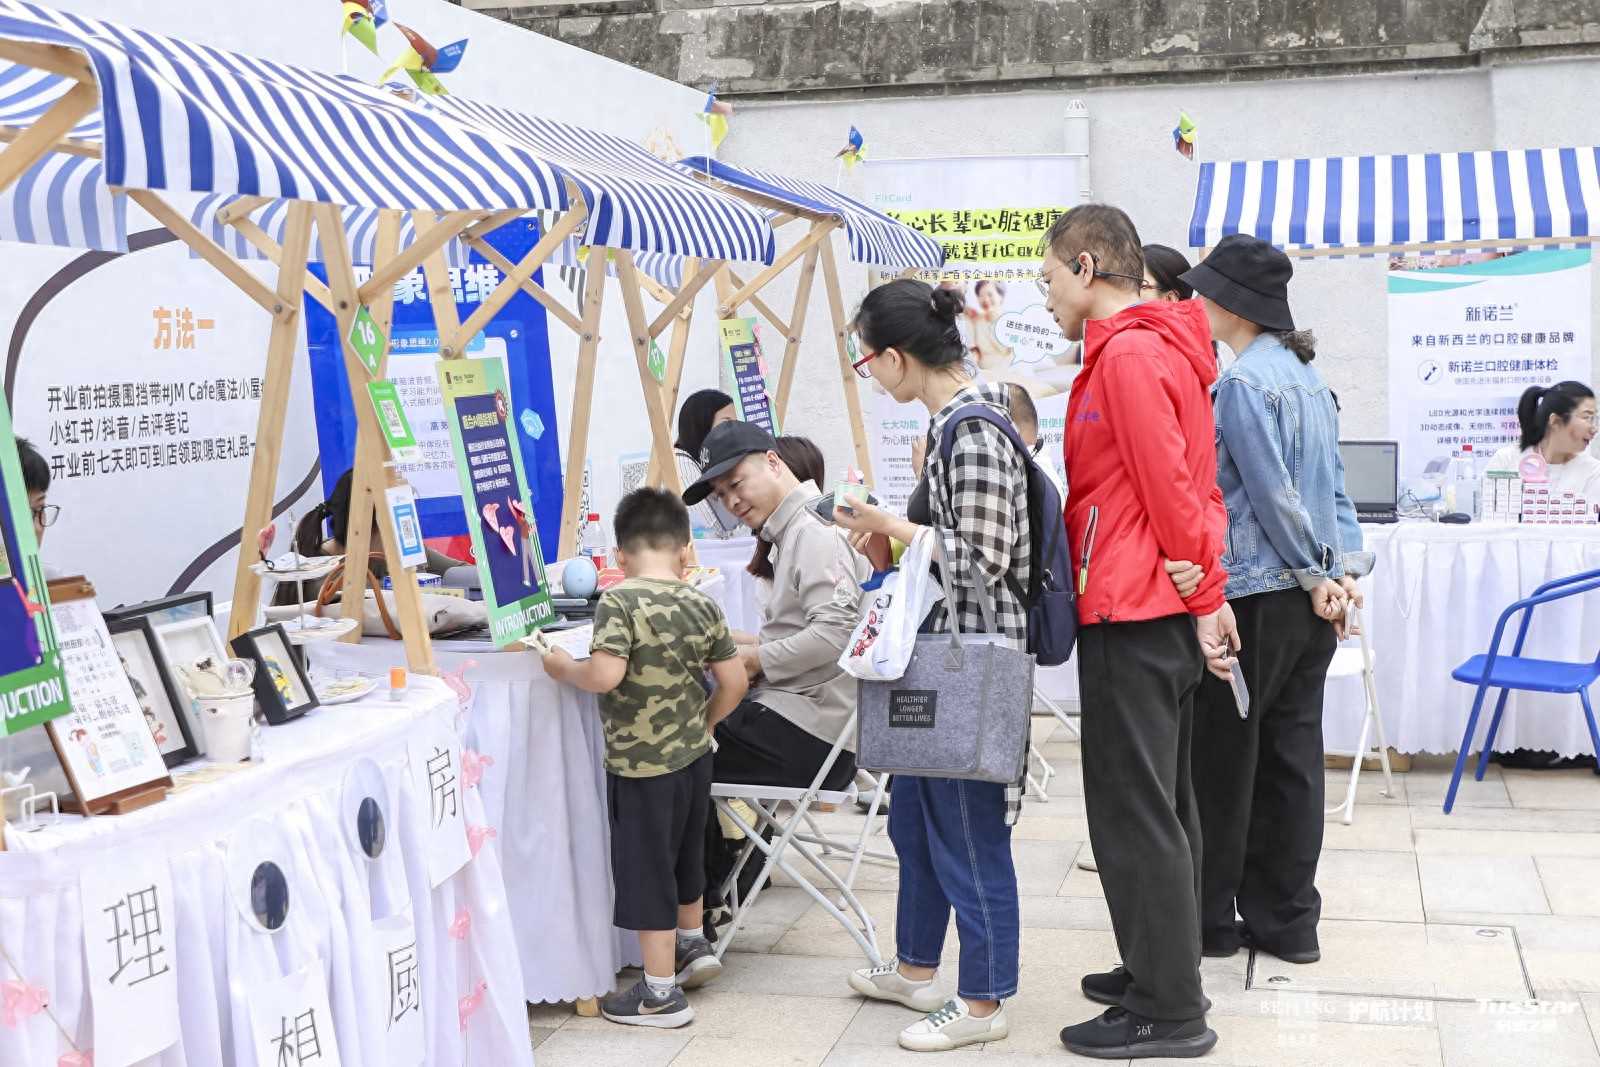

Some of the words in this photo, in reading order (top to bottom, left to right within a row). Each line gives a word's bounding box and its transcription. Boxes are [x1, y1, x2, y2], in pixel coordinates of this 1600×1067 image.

[1465, 305, 1514, 322] 新诺兰
[153, 306, 216, 350] 方法一
[358, 320, 376, 345] 16
[1411, 332, 1575, 347] 来自新西兰的口腔健康品牌
[1448, 358, 1558, 373] 新诺兰口腔健康体检
[188, 377, 264, 402] Cafe魔法小屋
[49, 411, 190, 446] 小红书/抖音/点评笔记
[881, 418, 919, 430] 七大功能
[496, 601, 552, 637] INTRODUCTION
[896, 695, 928, 703] HEALTHIER
[892, 714, 913, 722] BETTER
[426, 747, 456, 829] 房
[103, 885, 170, 987] 理
[386, 941, 420, 1032] 厨
